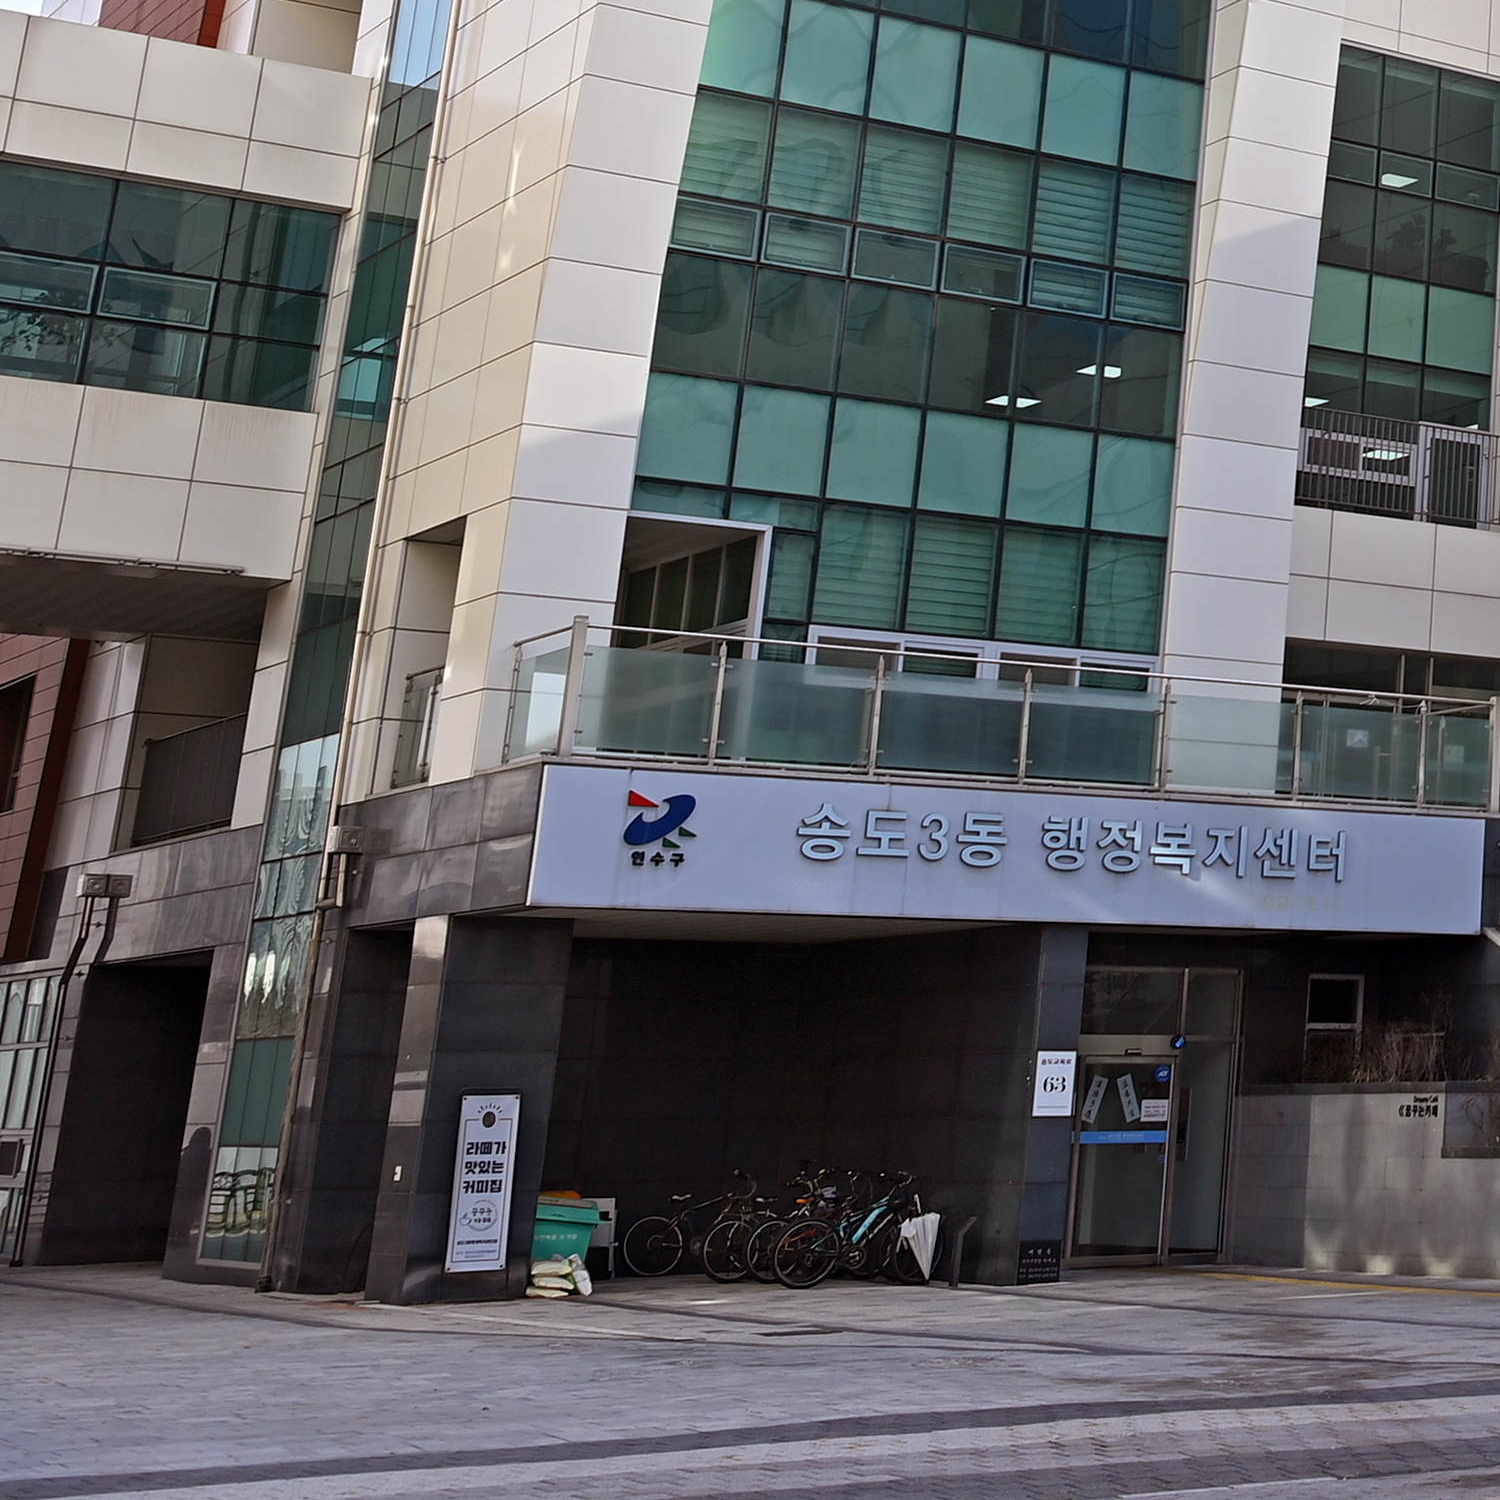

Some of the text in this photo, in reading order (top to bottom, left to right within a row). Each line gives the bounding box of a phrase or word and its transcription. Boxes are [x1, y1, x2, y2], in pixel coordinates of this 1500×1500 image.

[797, 803, 1347, 881] 송도3동 행정복지센터
[631, 851, 685, 868] 연수구
[1043, 1075, 1066, 1093] 63
[466, 1141, 507, 1156] 라떼가
[465, 1160, 504, 1175] 맛있는
[462, 1179, 502, 1194] 커피집
